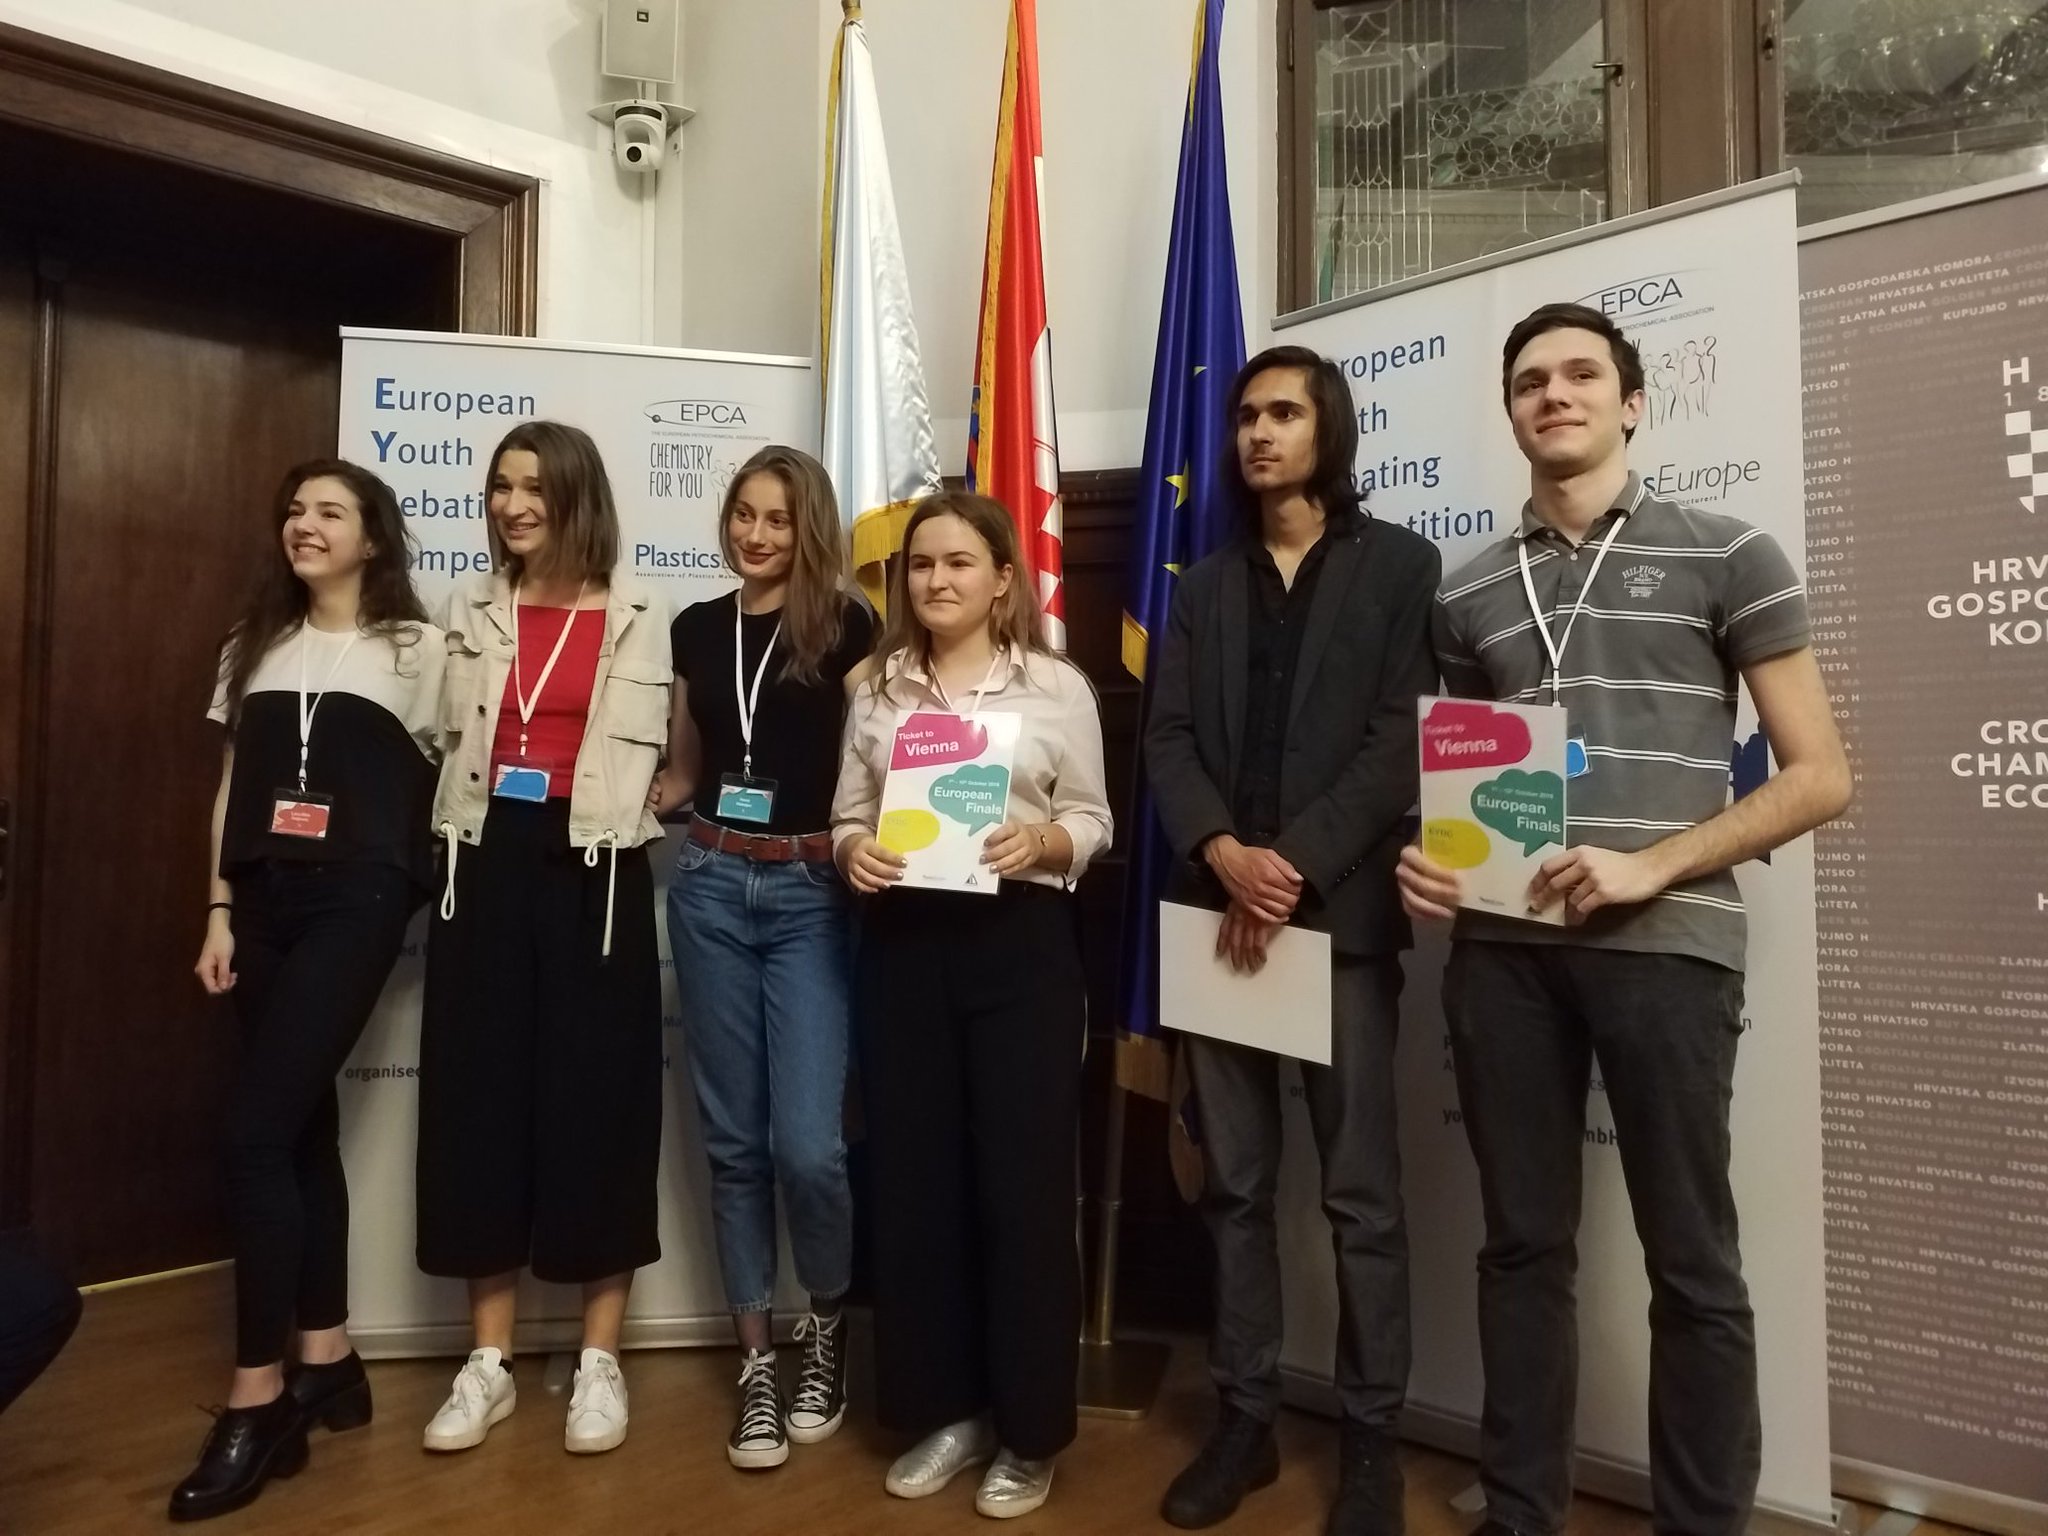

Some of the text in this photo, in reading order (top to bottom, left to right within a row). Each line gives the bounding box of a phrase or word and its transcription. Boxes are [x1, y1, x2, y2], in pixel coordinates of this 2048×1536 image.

[1799, 254, 1993, 301] ATSKA GOSPODARSKA KOMORA
[1869, 282, 1934, 303] HRVATSKA
[1940, 267, 2011, 289] KVALITETA
[1601, 278, 1683, 315] EPCA
[1621, 306, 1715, 332] TROCHEMICAL ASSOCIATION
[1839, 307, 1887, 325] ZLATNA
[1890, 299, 1927, 315] KUNA
[1942, 301, 2008, 321] KUPUJMO
[1340, 334, 1445, 383] ropean
[1801, 379, 1839, 393] ATSKO
[375, 378, 535, 420] European
[681, 404, 747, 425] EPCA
[1358, 401, 1388, 434] th
[1803, 426, 1842, 440] LITETA
[371, 431, 473, 466] Youth
[650, 442, 713, 470] CHEMISTRY
[1804, 458, 1838, 470] UJMO
[1360, 456, 1442, 491] ating
[1643, 460, 1761, 499] sEurope
[1804, 474, 1842, 487] ATSKO
[649, 471, 703, 498] FOR YOU
[400, 489, 485, 519] ebati
[1806, 505, 1844, 517] LITETA
[1407, 507, 1494, 540] tition
[1807, 537, 1841, 548] UJMO
[418, 549, 490, 578] mpe
[635, 543, 722, 569] Plastics
[1806, 552, 1845, 563] ATSKO
[1622, 565, 1666, 580] HILFIGER
[1973, 554, 2048, 585] HRV
[1808, 584, 1848, 595] LITETA
[1927, 587, 2048, 619] GOSPO
[1814, 648, 1839, 657] ORA
[1820, 662, 1850, 672] TETA
[898, 729, 934, 741] Ticket to
[1980, 719, 2048, 745] CRO
[905, 741, 960, 757] Vienna
[1434, 738, 1498, 756] Vienna
[934, 786, 993, 800] European
[966, 802, 1002, 815] Finals
[1477, 795, 1547, 815] European
[1516, 816, 1562, 833] Finals
[1815, 852, 1852, 862] UJMO
[1815, 868, 1856, 877] ATSKO
[1818, 932, 1855, 941] UJMO
[1818, 947, 1859, 958] ATSKO
[1818, 963, 1851, 974] MORA
[1910, 1000, 2048, 1019] HRVATSKA GOSPODA
[1862, 1013, 1929, 1027] HRVATSKO
[1820, 1026, 1862, 1038] ATSKO
[2002, 1041, 2048, 1054] ZLATN
[1820, 1042, 1854, 1053] MORA
[1913, 1083, 1981, 1098] HRVATSKA
[1865, 1093, 1932, 1110] HRVATSKO
[1821, 1121, 1856, 1133] MORA
[2005, 1125, 2048, 1140] ZLATN
[1916, 1164, 1984, 1183] HRVATSKA
[2006, 1160, 2048, 1174] IZVOR
[1869, 1174, 1935, 1192] HRVATSKO
[1823, 1201, 1859, 1214] MORA
[2008, 1211, 2048, 1226] ZLATN
[1871, 1255, 1938, 1276] HRVATSKO
[1918, 1247, 1986, 1267] HRVATSKA
[1824, 1265, 1871, 1280] VATSKO
[1825, 1280, 1862, 1295] MORA
[1874, 1337, 1940, 1358] HRVATSKO
[1921, 1329, 1989, 1352] HRVATSKA
[1826, 1344, 1873, 1362] VATSKO
[1827, 1359, 1864, 1375] MORA
[1924, 1412, 1992, 1437] HRVATSKA
